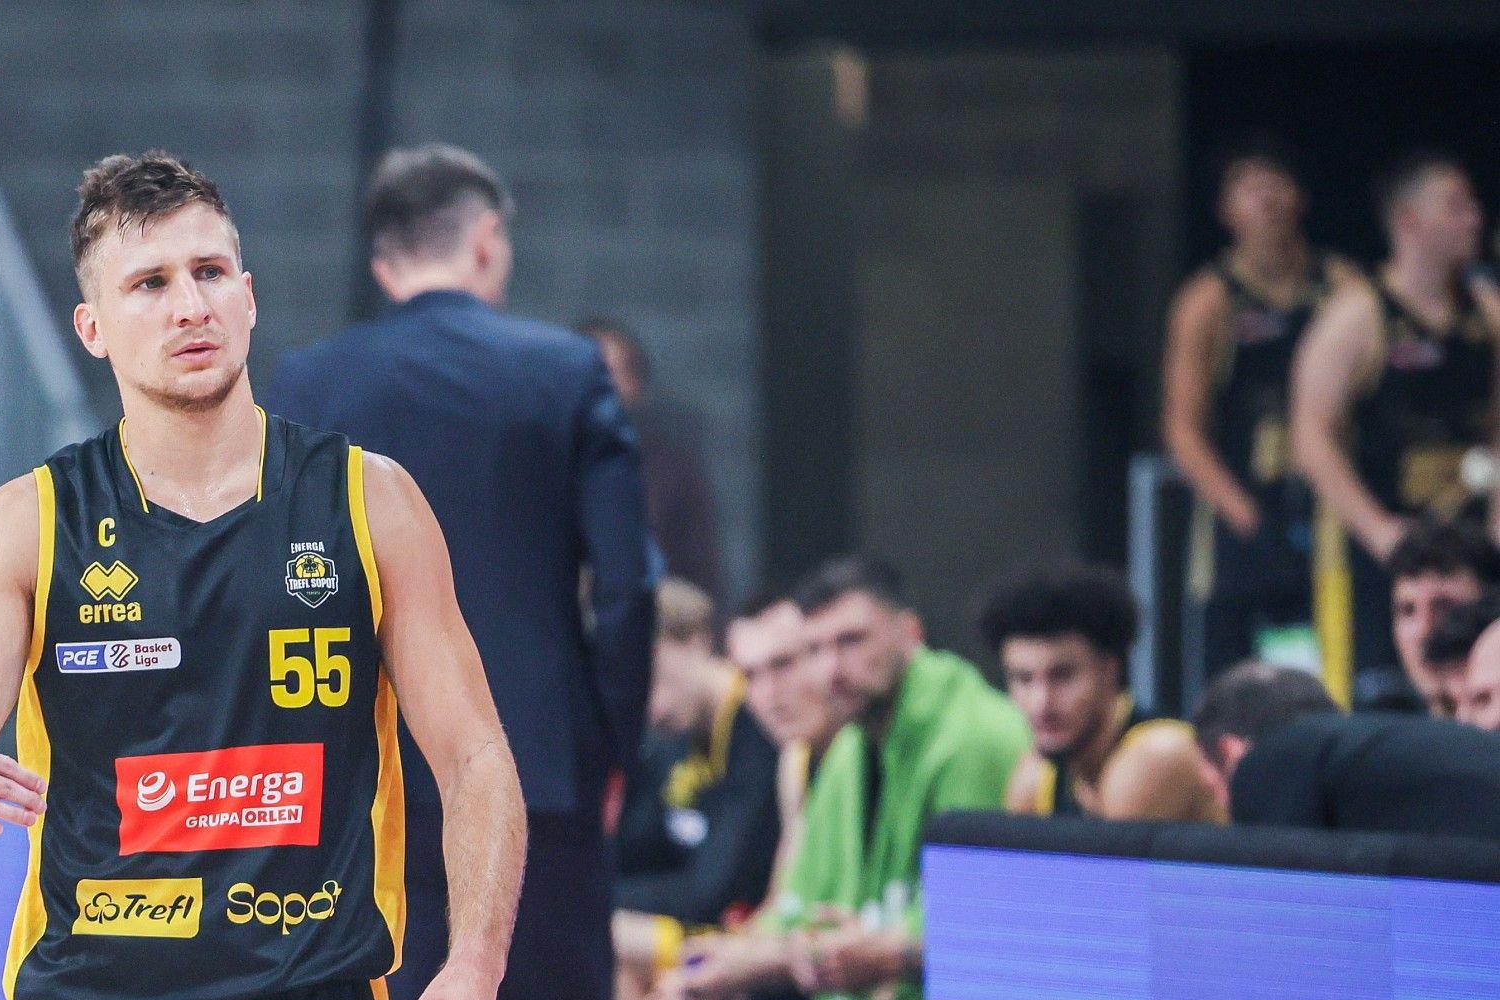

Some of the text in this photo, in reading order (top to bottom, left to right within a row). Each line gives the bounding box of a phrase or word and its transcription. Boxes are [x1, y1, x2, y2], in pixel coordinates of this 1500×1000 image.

[98, 517, 116, 547] C
[290, 541, 325, 554] ENERGA
[289, 577, 335, 590] TREFL SOPOT
[62, 649, 100, 666] PGE
[134, 642, 173, 654] Basket
[135, 655, 159, 667] Liga
[269, 627, 351, 709] 55
[187, 771, 304, 805] Energa
[185, 807, 301, 829] GRUPA ORLEN
[122, 893, 195, 925] Trefl
